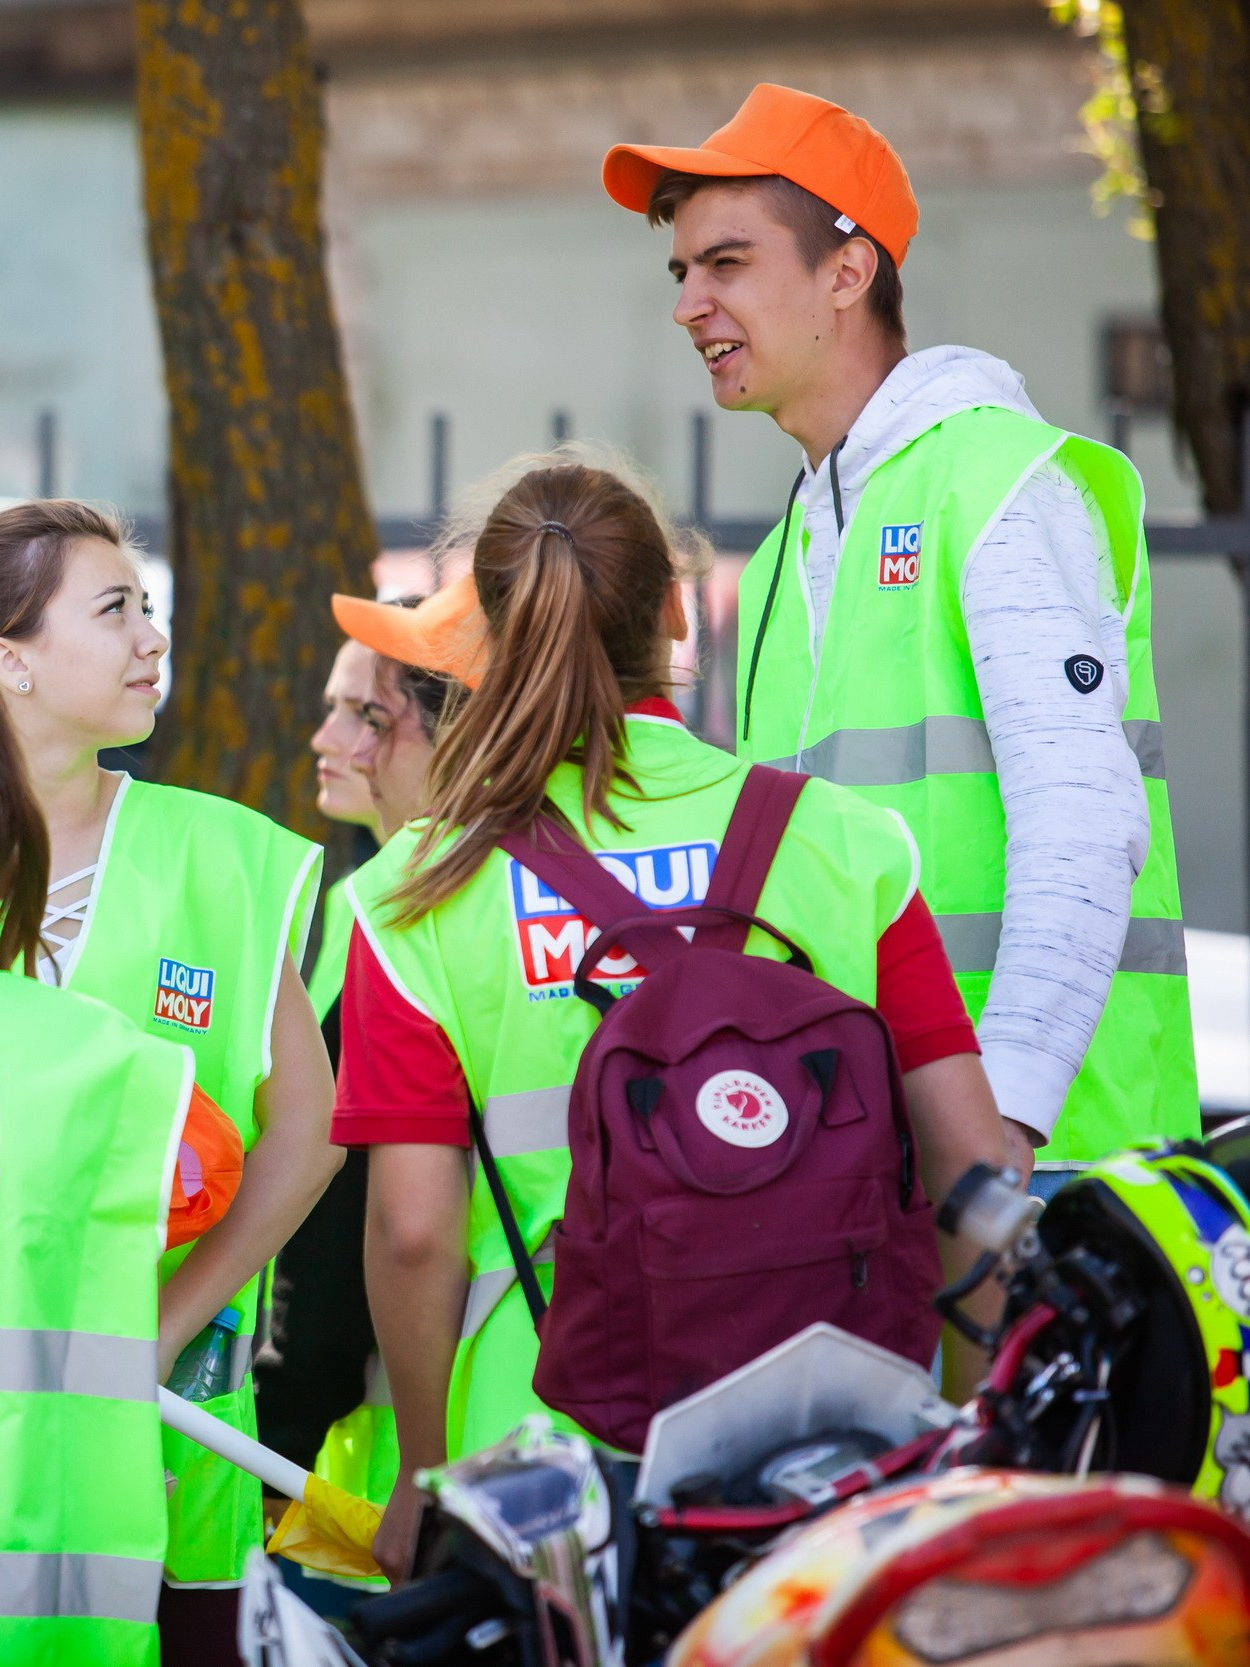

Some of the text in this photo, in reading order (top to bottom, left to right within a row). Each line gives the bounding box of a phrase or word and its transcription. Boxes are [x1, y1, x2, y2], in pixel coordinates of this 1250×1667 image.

[885, 527, 922, 553] LIQ
[520, 847, 710, 913] LUI
[160, 961, 210, 997] LIQUI
[152, 1017, 170, 1026] MADE
[156, 989, 210, 1025] MOLY
